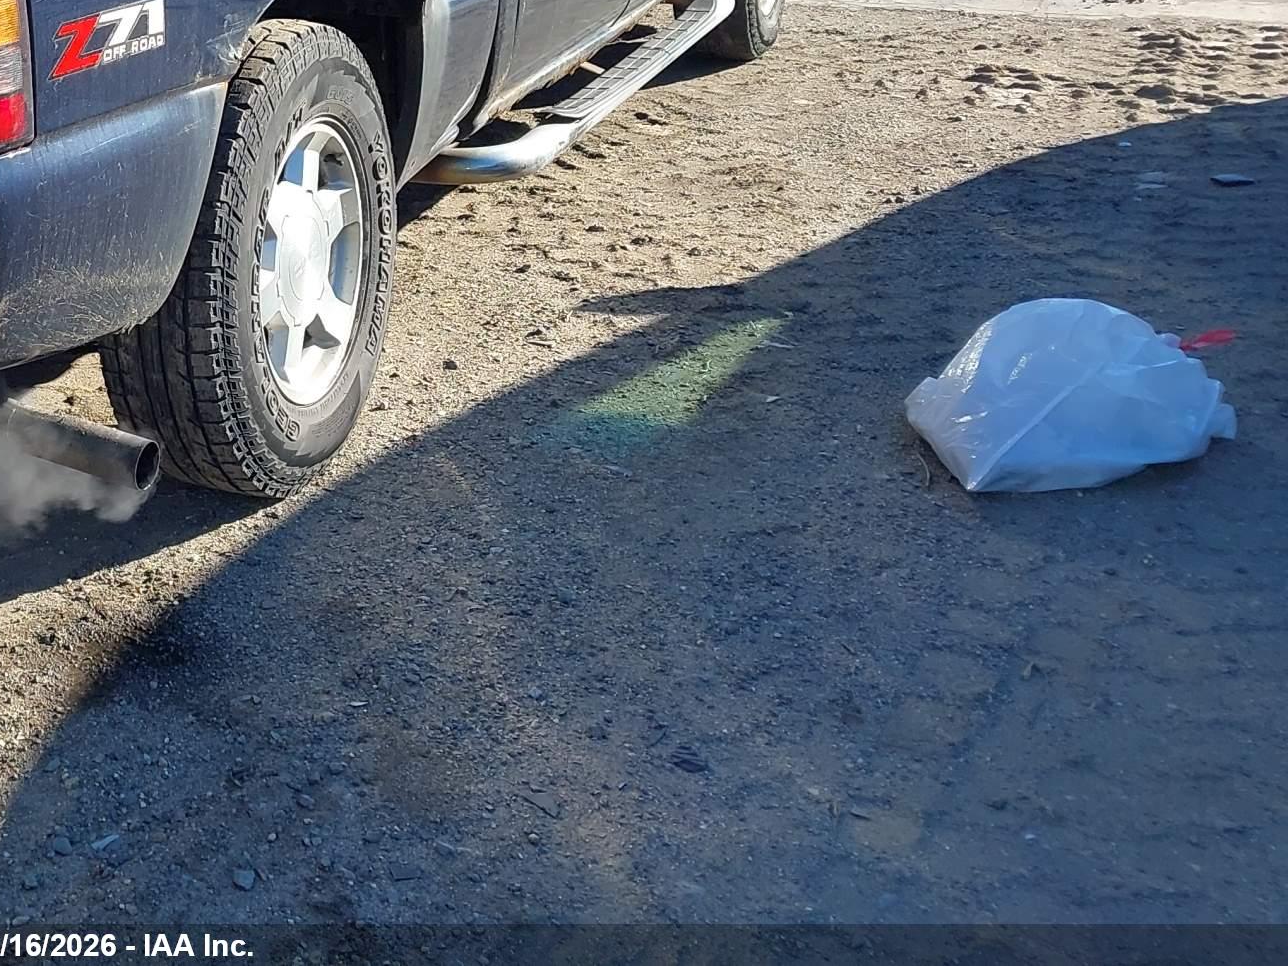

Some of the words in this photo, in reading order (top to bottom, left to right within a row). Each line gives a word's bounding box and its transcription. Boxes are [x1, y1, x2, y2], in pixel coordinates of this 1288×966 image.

[103, 45, 126, 64] OFF
[132, 35, 164, 55] ROAD
[367, 130, 391, 357] YOKOHAMA
